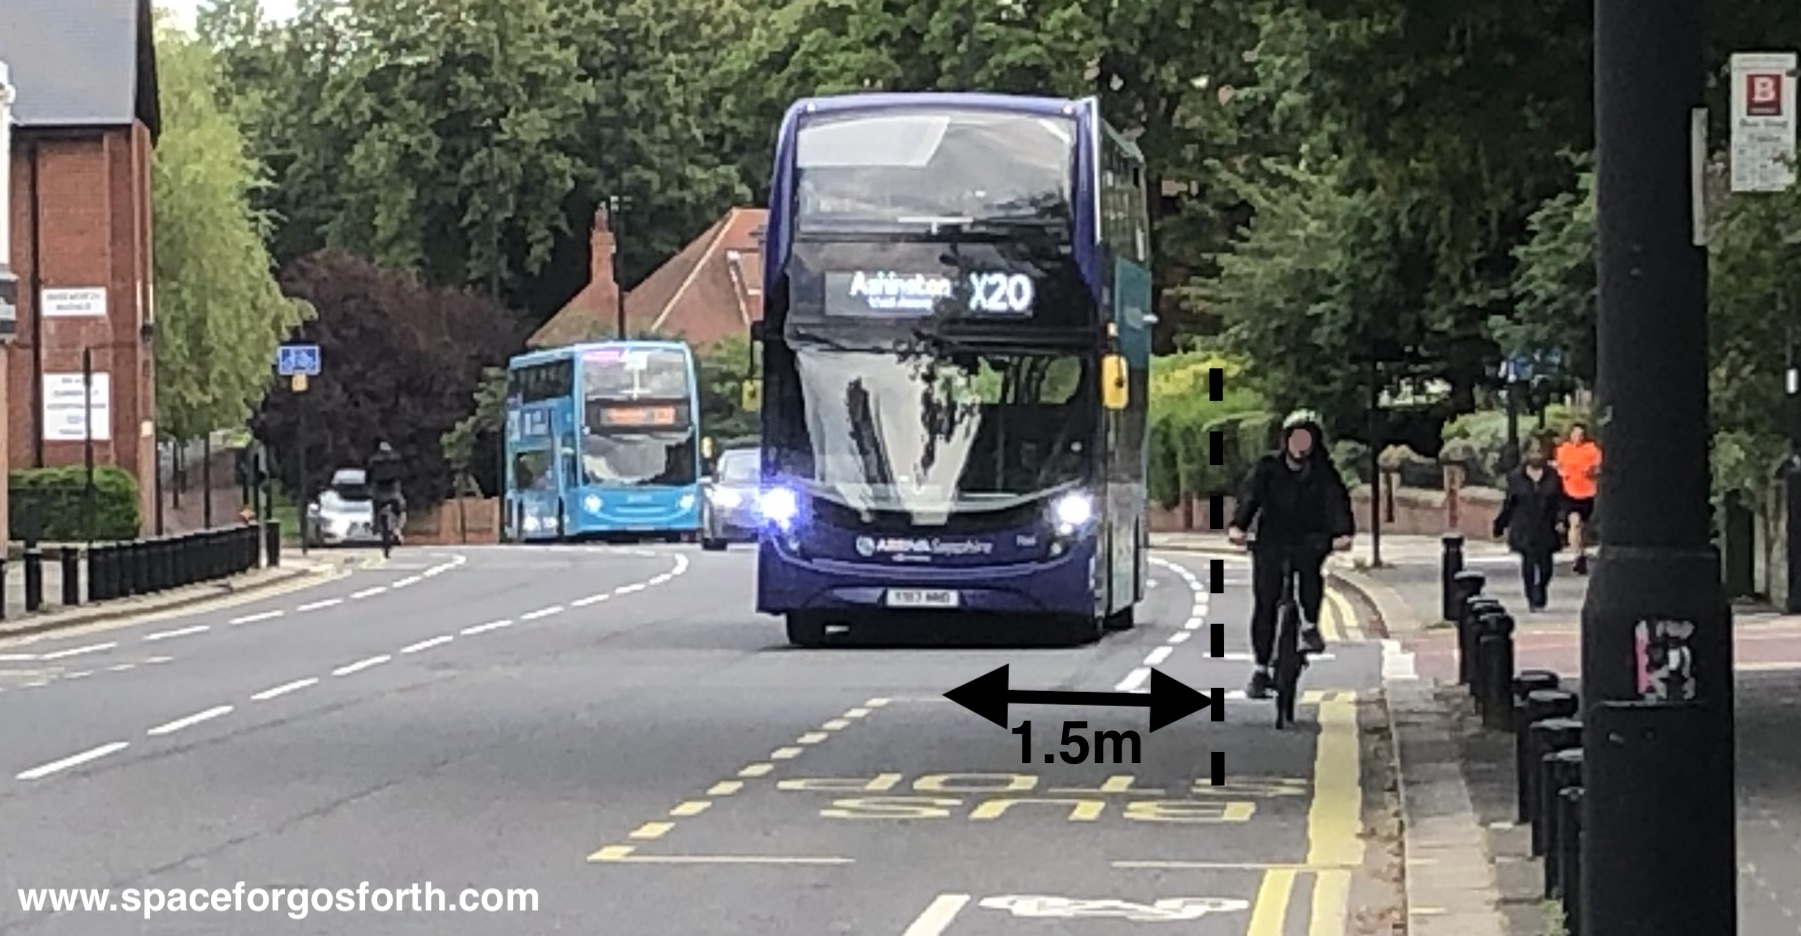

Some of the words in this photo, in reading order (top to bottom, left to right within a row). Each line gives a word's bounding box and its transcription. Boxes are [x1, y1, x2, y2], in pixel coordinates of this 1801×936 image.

[1752, 76, 1776, 103] B
[969, 271, 1033, 312] X20
[876, 538, 931, 552] ARRIVA
